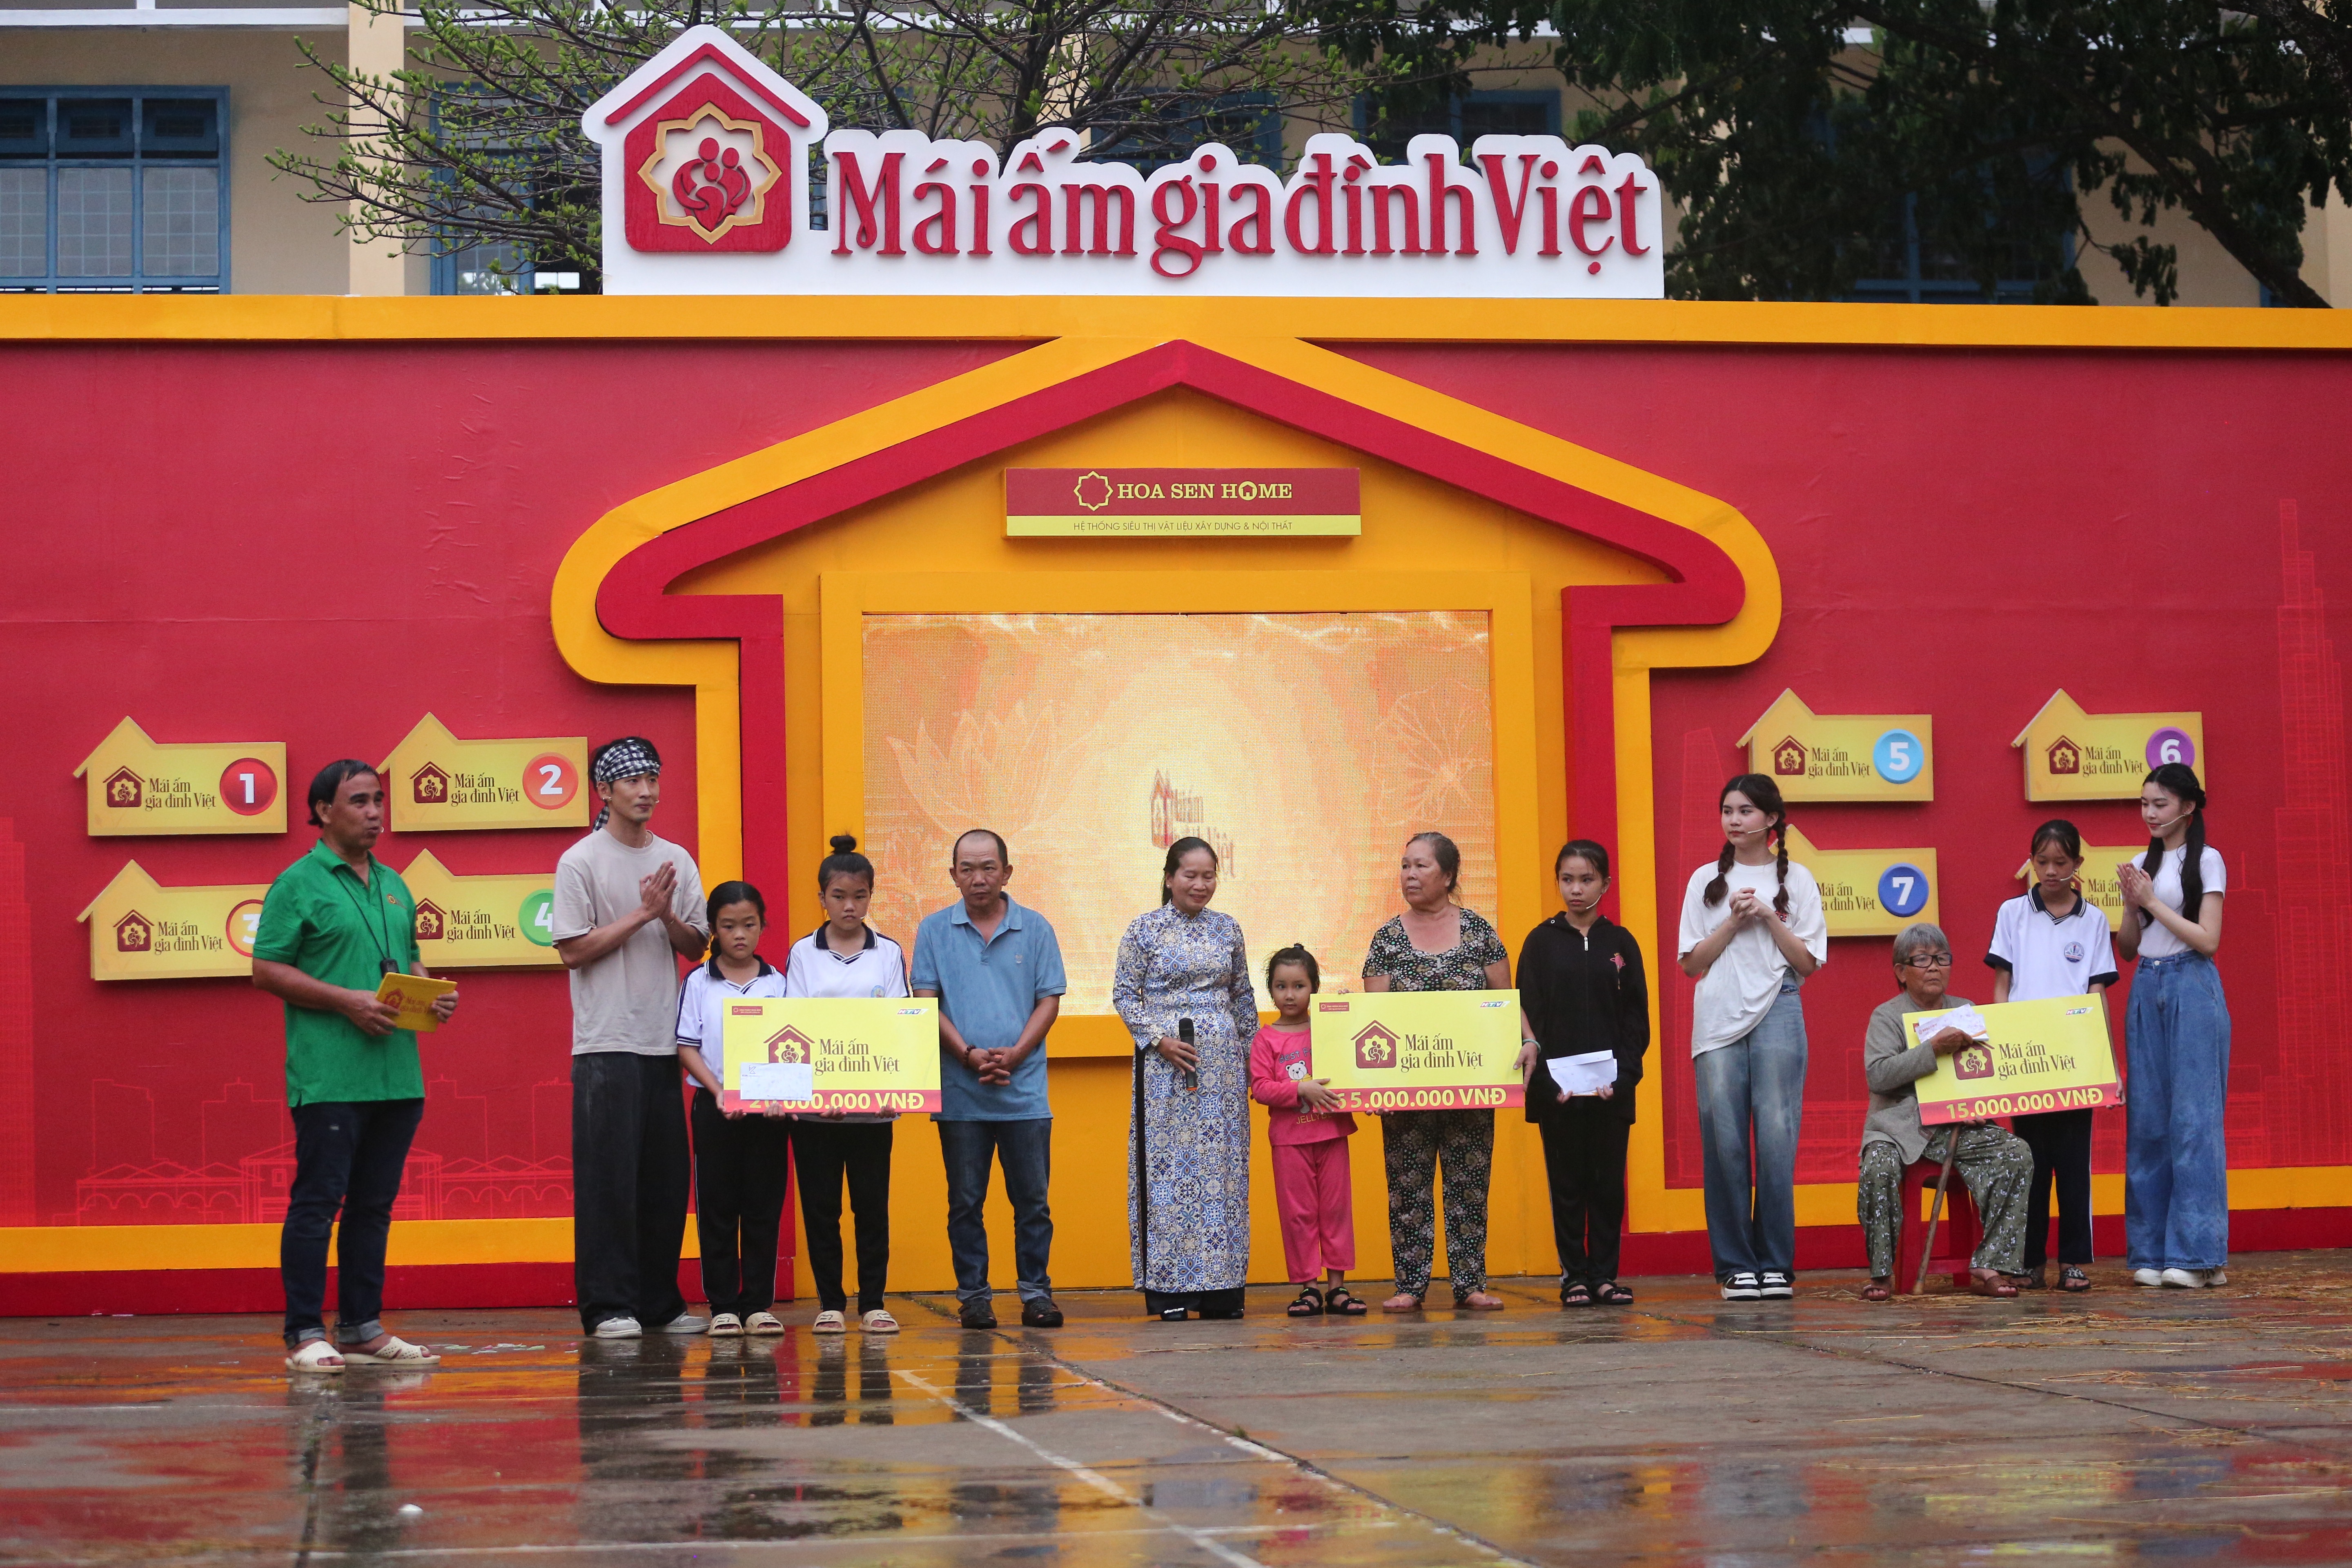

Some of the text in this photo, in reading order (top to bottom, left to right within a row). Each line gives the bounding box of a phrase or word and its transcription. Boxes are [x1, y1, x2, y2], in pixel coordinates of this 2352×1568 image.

[831, 139, 1650, 278] Mái ấm gia đình Việt
[1117, 483, 1165, 499] HOA
[1170, 483, 1214, 499] SEN
[1074, 521, 1085, 532] HỆ
[1087, 521, 1120, 530] THỐNG
[1123, 521, 1140, 530] SIÊU
[1143, 522, 1156, 532] THỊ
[1158, 521, 1174, 532] VẬT
[1176, 521, 1193, 532] LIỆU
[1195, 521, 1212, 530] XÂY
[1214, 522, 1241, 532] DỰNG
[1252, 521, 1269, 532] NỘI
[1272, 520, 1292, 530] THẤT
[1812, 747, 1848, 761] Mái ấm
[1889, 742, 1910, 771] 5
[2086, 745, 2121, 760] Mái ấm
[2160, 739, 2182, 764] 6
[1809, 762, 1871, 779] gia đình Việt
[2083, 760, 2143, 777] gia đình Việt
[149, 777, 191, 793] Mái ấm
[240, 773, 255, 804] 1
[455, 773, 494, 788] Mái ấm
[539, 764, 563, 795] 2
[145, 793, 216, 811] gia đình Việt
[451, 788, 519, 807] gia đình Việt
[1837, 882, 1853, 895] ấm
[1892, 876, 1914, 906] 7
[2088, 878, 2105, 892] Mái
[1831, 896, 1854, 911] đình
[1856, 896, 1875, 911] Việt
[451, 909, 491, 924] Mái ấm
[535, 902, 553, 932] 4
[158, 920, 198, 936] Mái ấm
[243, 914, 261, 944] 3
[447, 924, 516, 943] gia đình Việt
[155, 935, 223, 955] gia đình Việt
[2065, 1007, 2094, 1015] HTV7
[819, 1038, 869, 1055] Mái ấm
[1405, 1033, 1453, 1051] Mái ấm
[1998, 1040, 2046, 1060] Mái ấm
[1279, 1050, 1300, 1063] Best
[1401, 1050, 1483, 1073] gia đình Việt
[815, 1056, 900, 1076] gia đình Việt
[1998, 1054, 2076, 1081] gia đình Việt
[1458, 1088, 1506, 1105] VNĐ
[1946, 1087, 2103, 1119] 15.000.000 VNĐ
